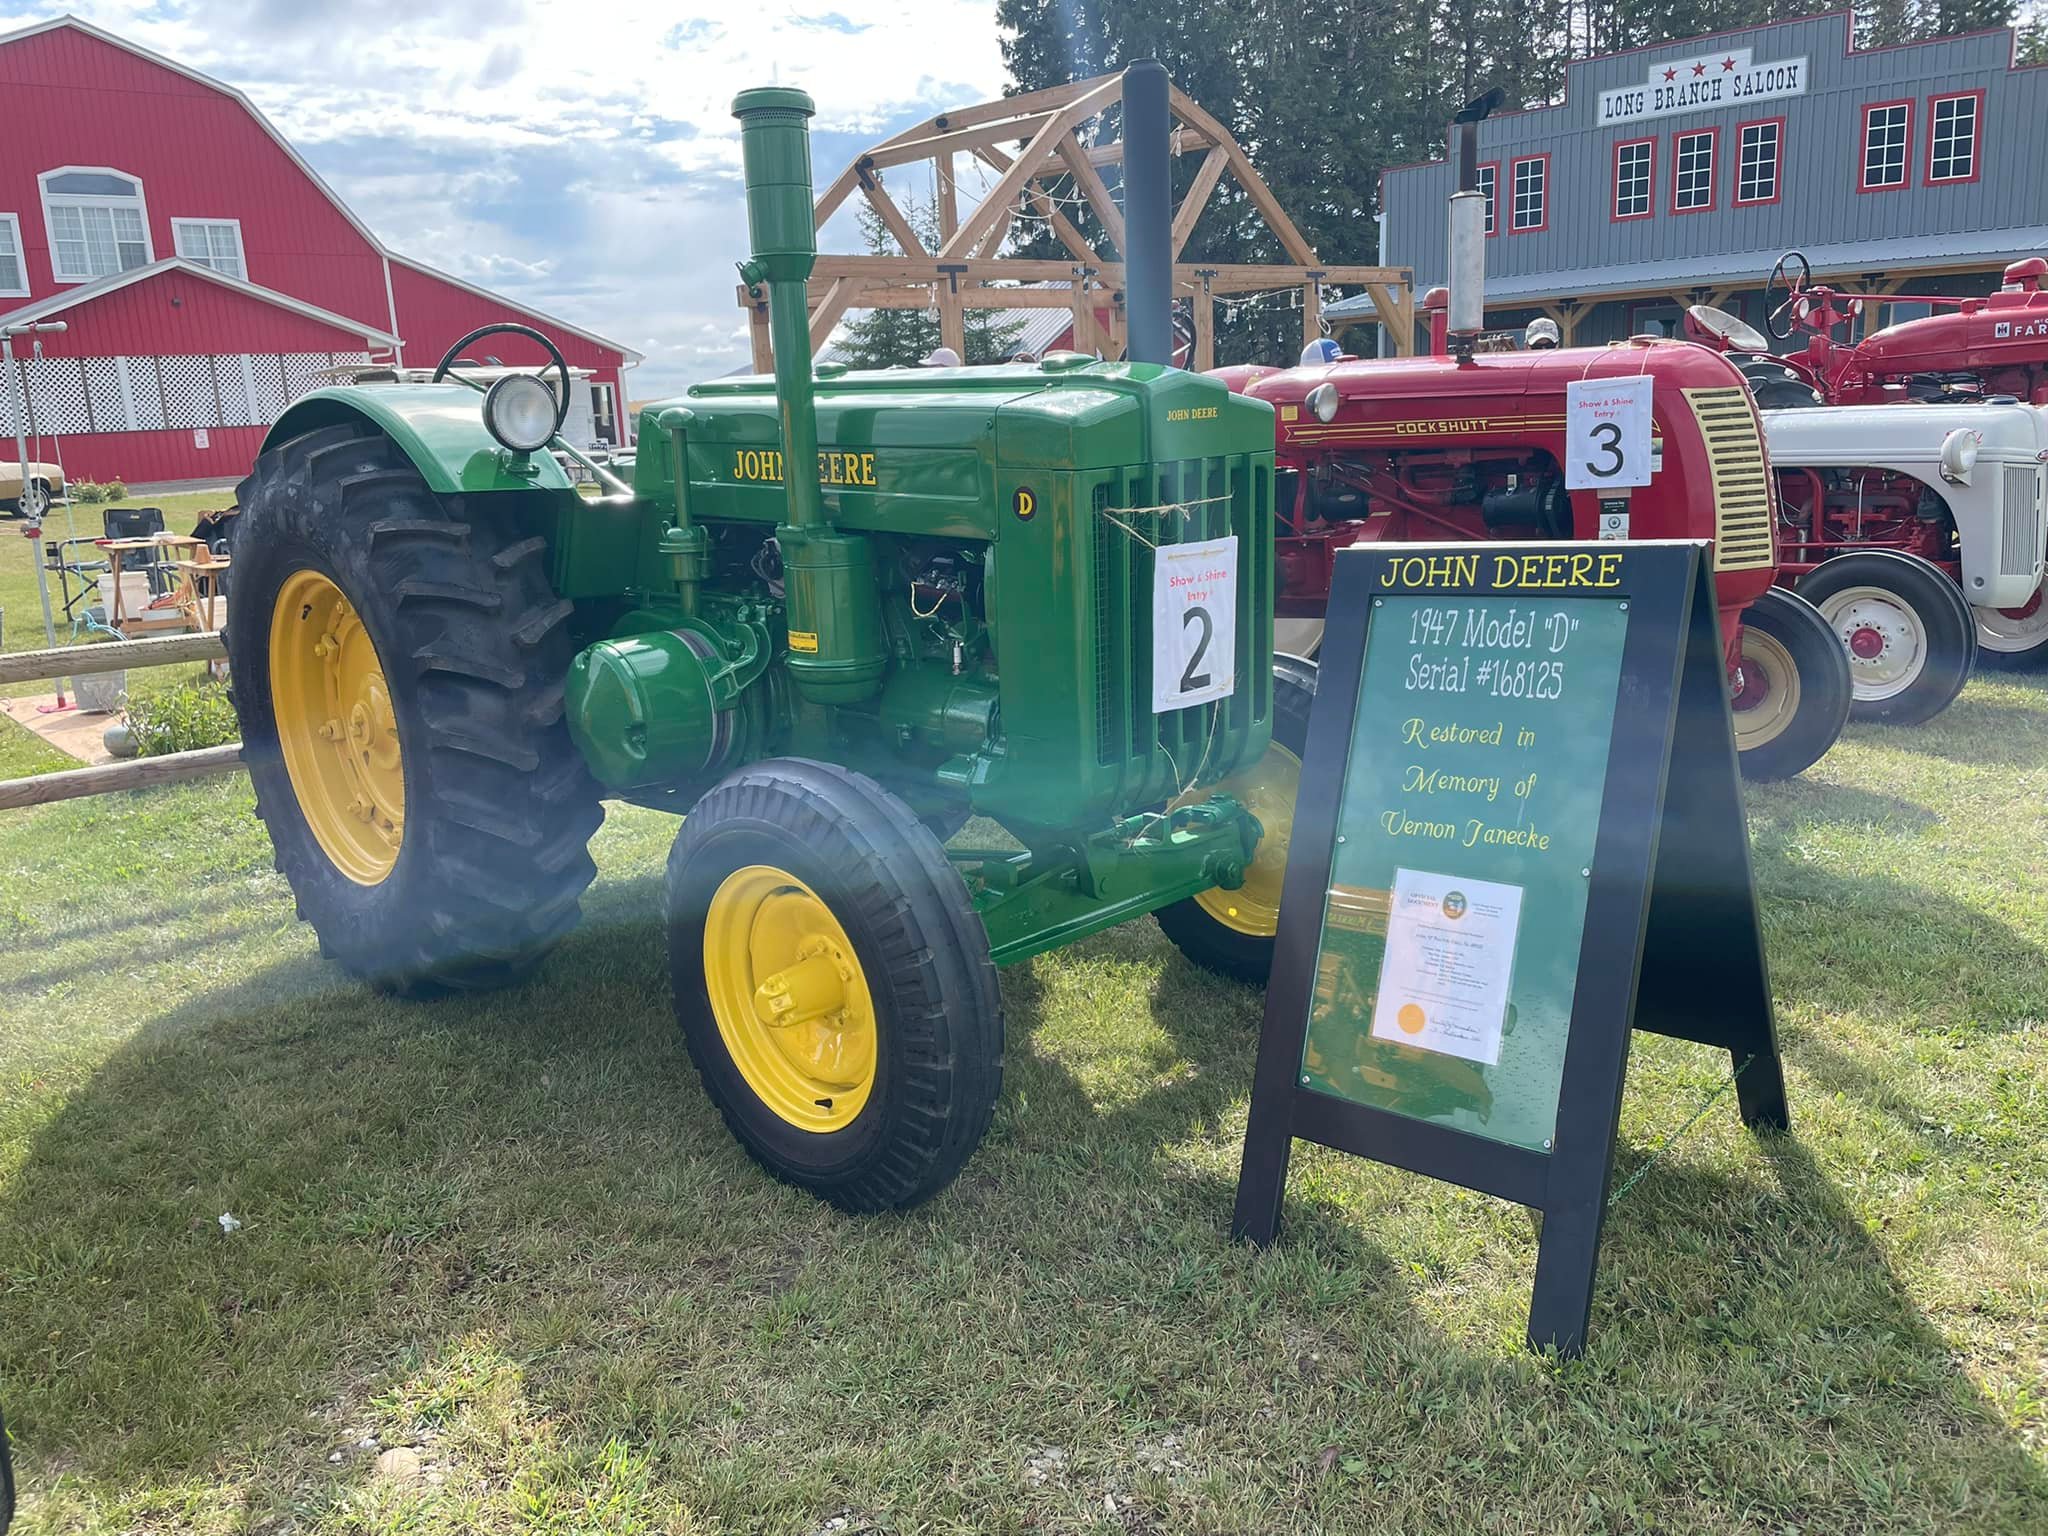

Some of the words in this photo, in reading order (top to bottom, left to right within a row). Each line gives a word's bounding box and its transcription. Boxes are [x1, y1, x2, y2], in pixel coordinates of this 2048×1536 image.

[1605, 91, 1644, 118] LONG
[1654, 78, 1723, 111] BRANCH
[1733, 65, 1799, 97] SALOON
[1167, 408, 1190, 421] JOHN
[1191, 407, 1218, 419] DEERE
[1578, 400, 1602, 409] Show
[1611, 397, 1634, 406] Shine
[1594, 410, 1615, 418] Entry
[1396, 420, 1488, 433] COCKSHUTT
[1586, 422, 1624, 477] 3
[817, 452, 877, 485] EERE
[1017, 492, 1034, 518] D
[1169, 576, 1194, 587] Show
[1204, 568, 1228, 582] Shine
[1381, 555, 1480, 588] JOHN
[1491, 553, 1623, 588] DEERE
[1187, 591, 1208, 602] Entry
[1409, 607, 1458, 647] 1947
[1462, 609, 1535, 650] Model
[1544, 612, 1581, 653] "D"
[1180, 606, 1213, 693] 2
[1405, 653, 1470, 693] Serial
[1476, 661, 1564, 700] #168125
[1402, 718, 1504, 748] Restored
[1517, 726, 1536, 747] in
[1402, 765, 1499, 801] Memory
[1514, 772, 1538, 799] of
[1380, 809, 1456, 841] Vernon
[1462, 819, 1550, 851] Janecke
